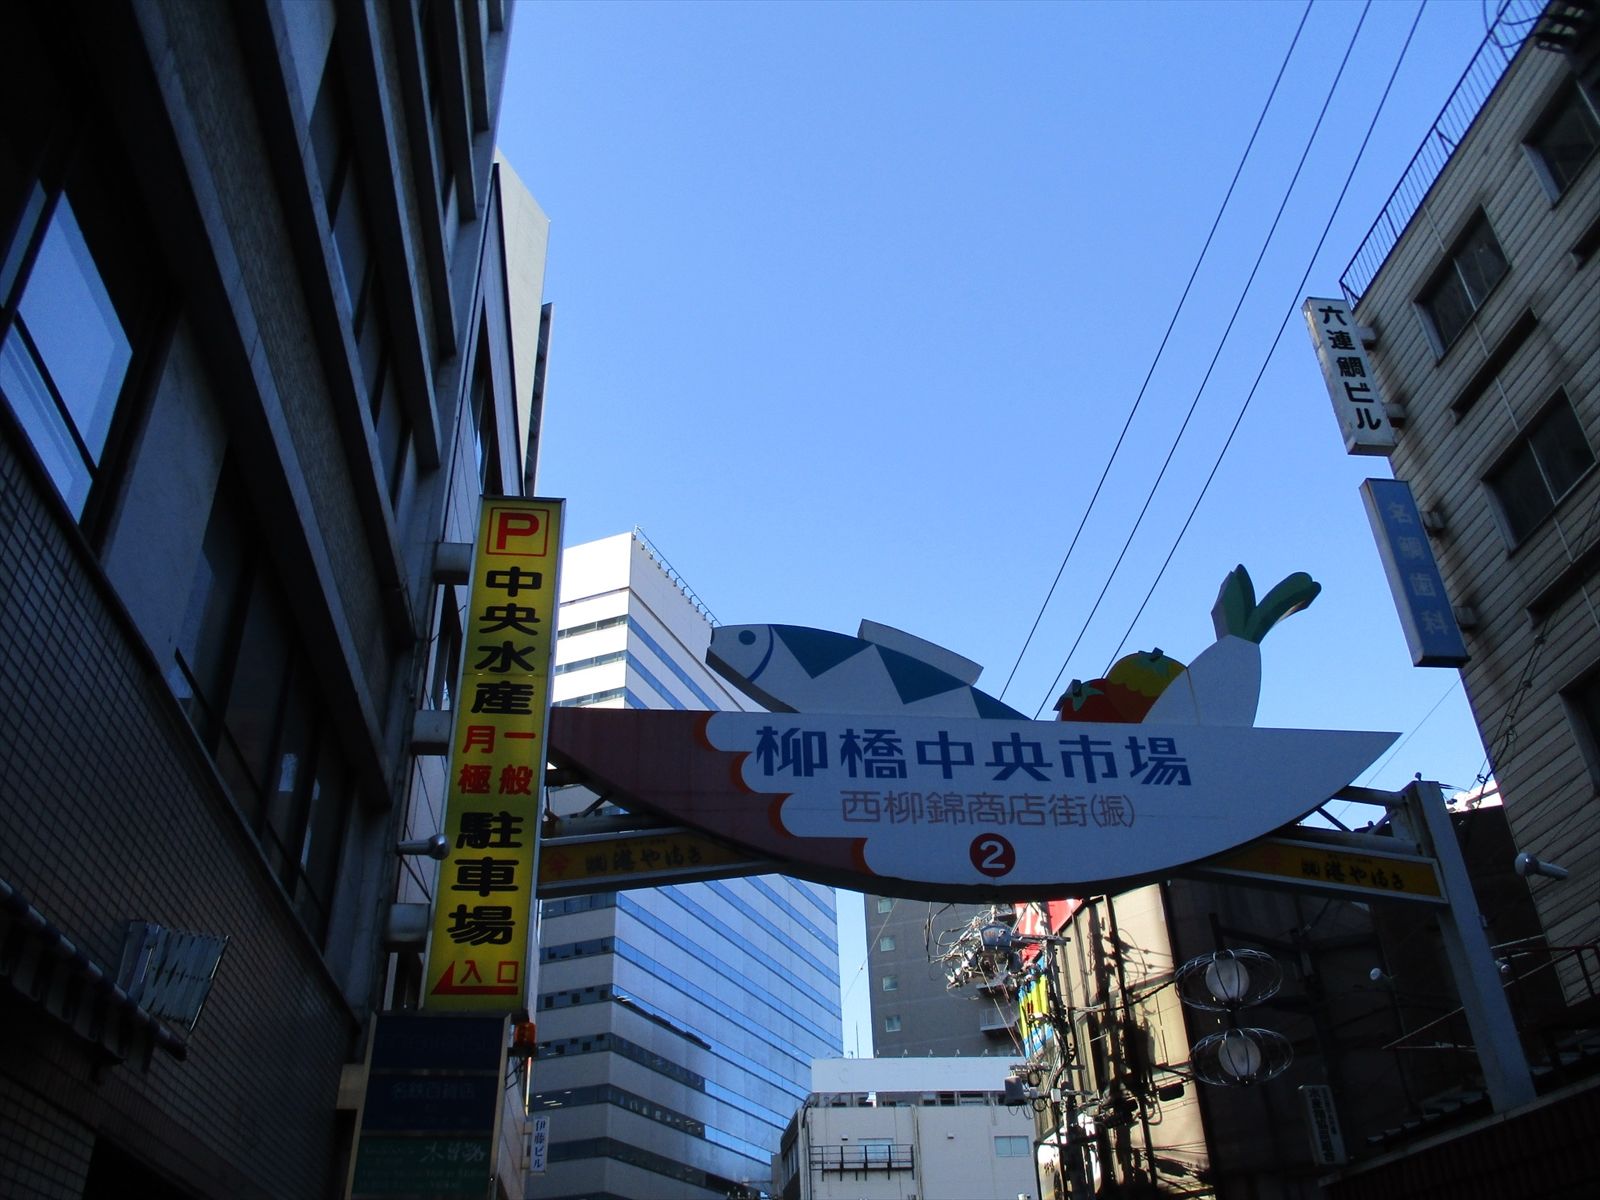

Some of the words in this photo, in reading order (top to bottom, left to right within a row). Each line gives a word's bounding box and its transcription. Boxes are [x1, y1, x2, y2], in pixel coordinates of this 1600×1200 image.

[1318, 305, 1381, 431] 六連鯛ビル
[496, 512, 539, 550] P
[471, 566, 542, 714] 中央水産
[458, 725, 495, 794] 月極
[498, 733, 536, 795] 一般
[755, 725, 1193, 786] 柳橋中央市場
[446, 810, 524, 946] 駐車場
[460, 959, 519, 984] 入口
